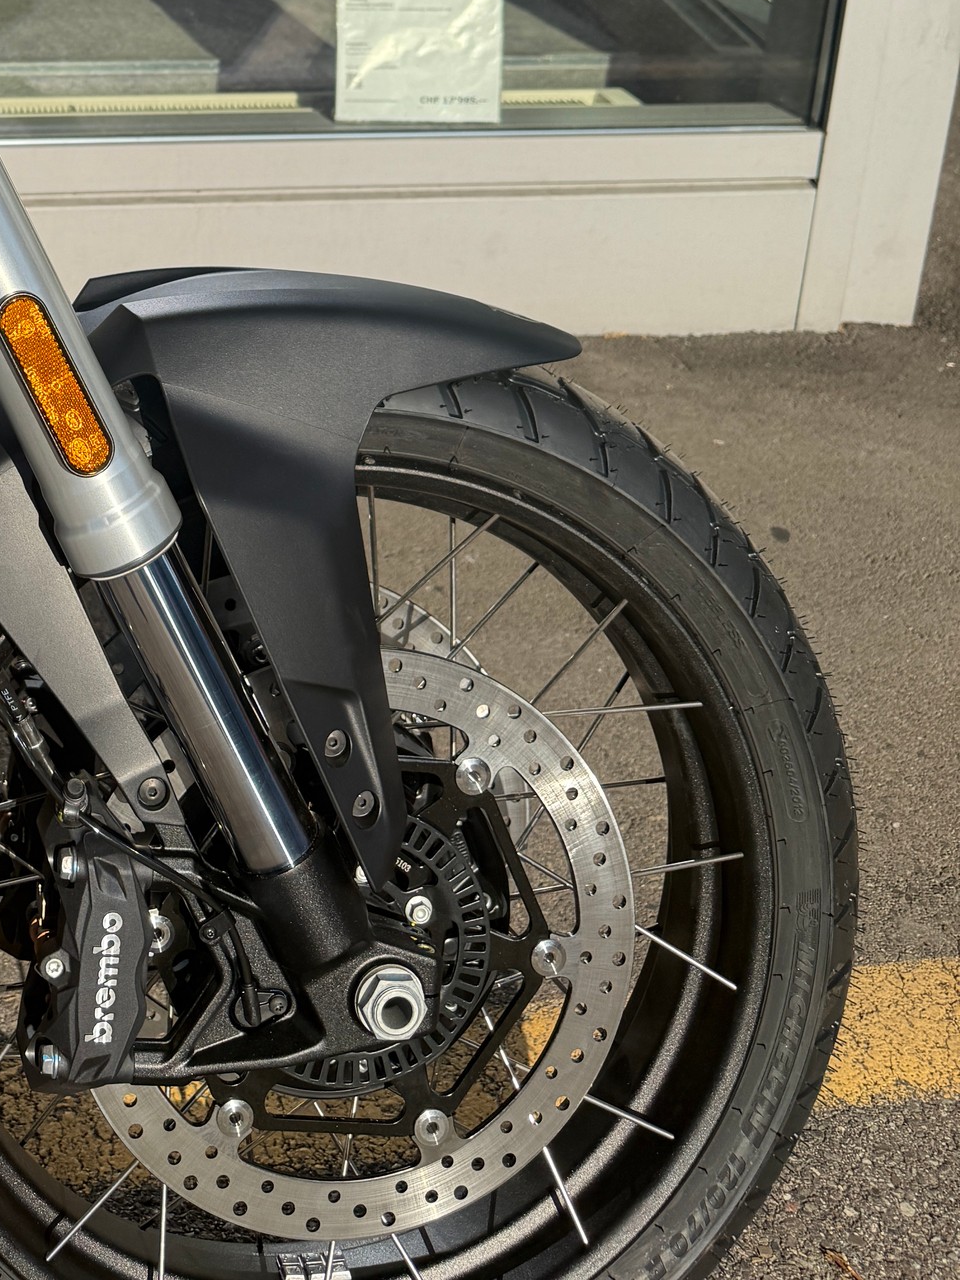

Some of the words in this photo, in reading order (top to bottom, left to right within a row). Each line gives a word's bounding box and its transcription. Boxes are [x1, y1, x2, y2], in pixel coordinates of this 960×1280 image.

[1, 688, 18, 712] PTFE
[84, 912, 123, 1045] brembo
[747, 940, 817, 1136] MICHELIN
[669, 1152, 747, 1258] 120/70
